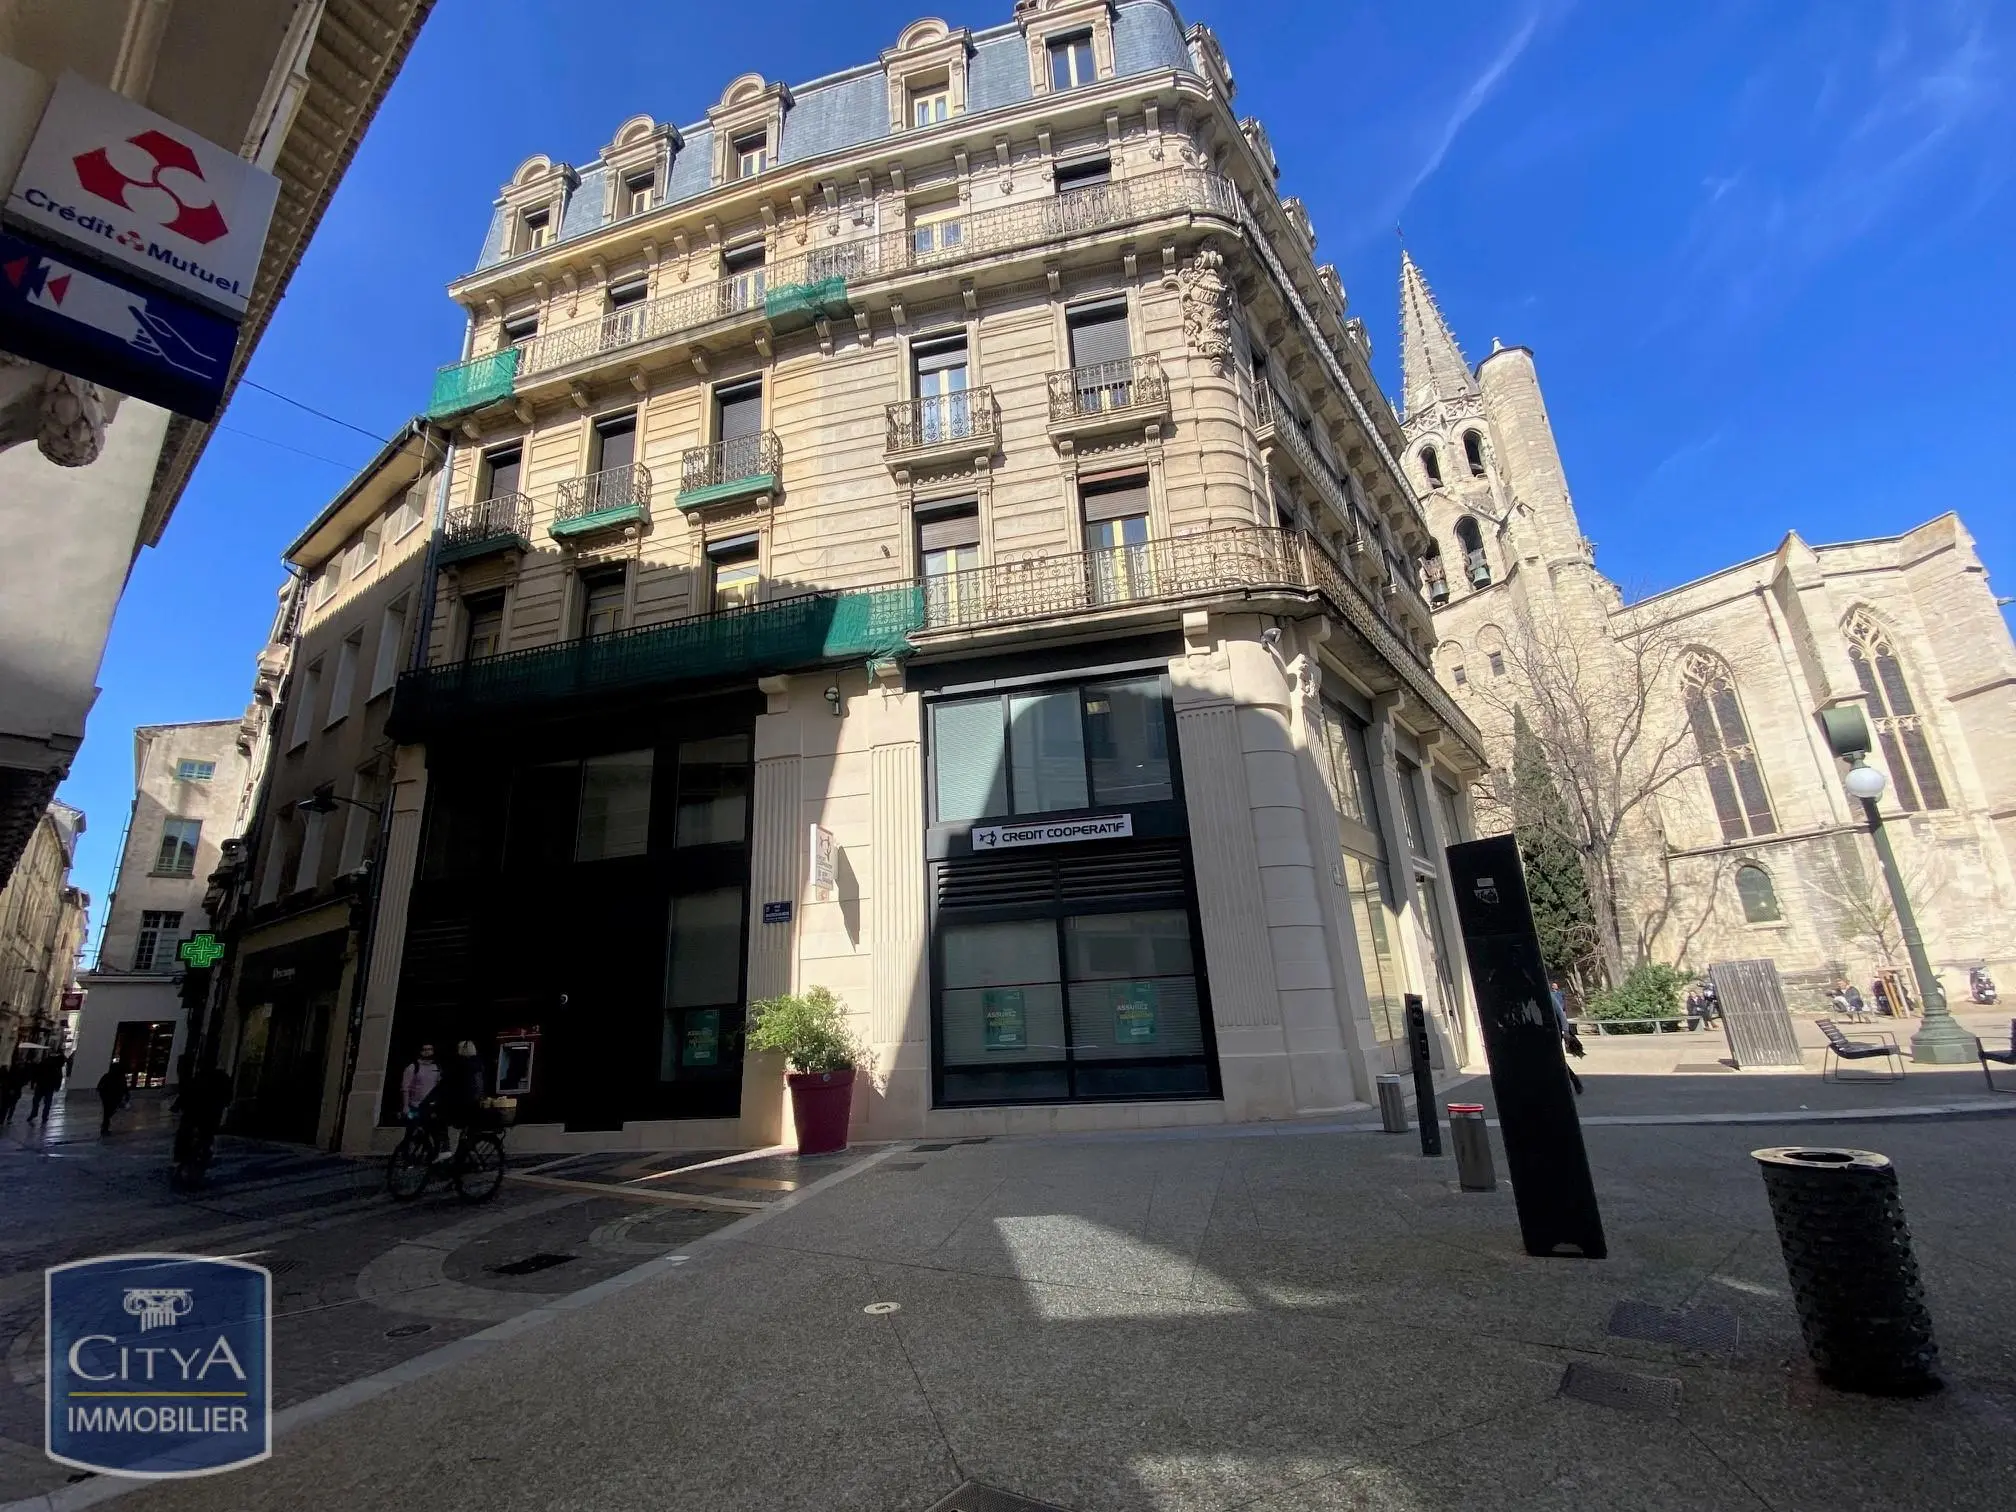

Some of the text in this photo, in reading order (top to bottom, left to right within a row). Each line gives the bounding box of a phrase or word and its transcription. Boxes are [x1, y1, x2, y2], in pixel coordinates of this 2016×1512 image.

[24, 188, 239, 296] Crédit Mutuel
[1002, 822, 1125, 842] CREDIT COOPERATIF
